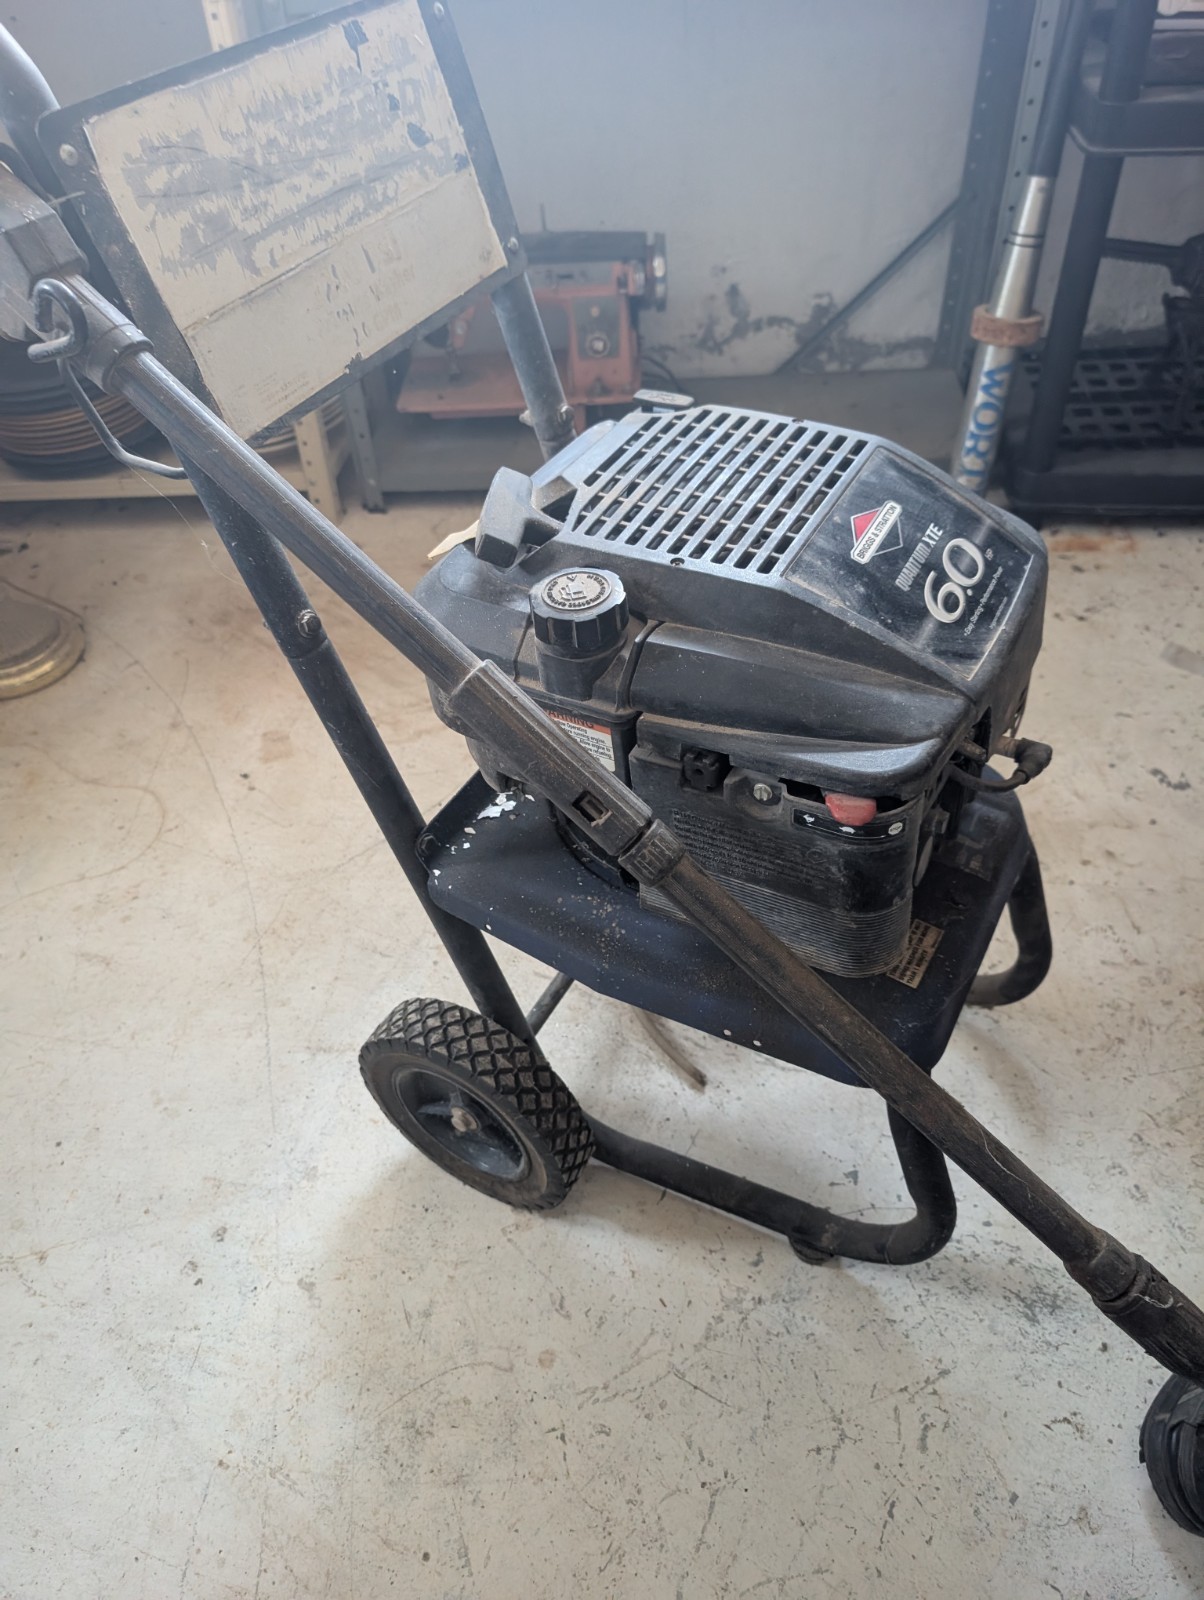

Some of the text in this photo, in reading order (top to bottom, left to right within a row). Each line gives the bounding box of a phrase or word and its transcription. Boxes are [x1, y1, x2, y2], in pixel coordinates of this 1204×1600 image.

[855, 503, 897, 560] BRIGGS & STRATTON
[927, 522, 944, 548] XTE
[923, 537, 986, 624] 6.0
